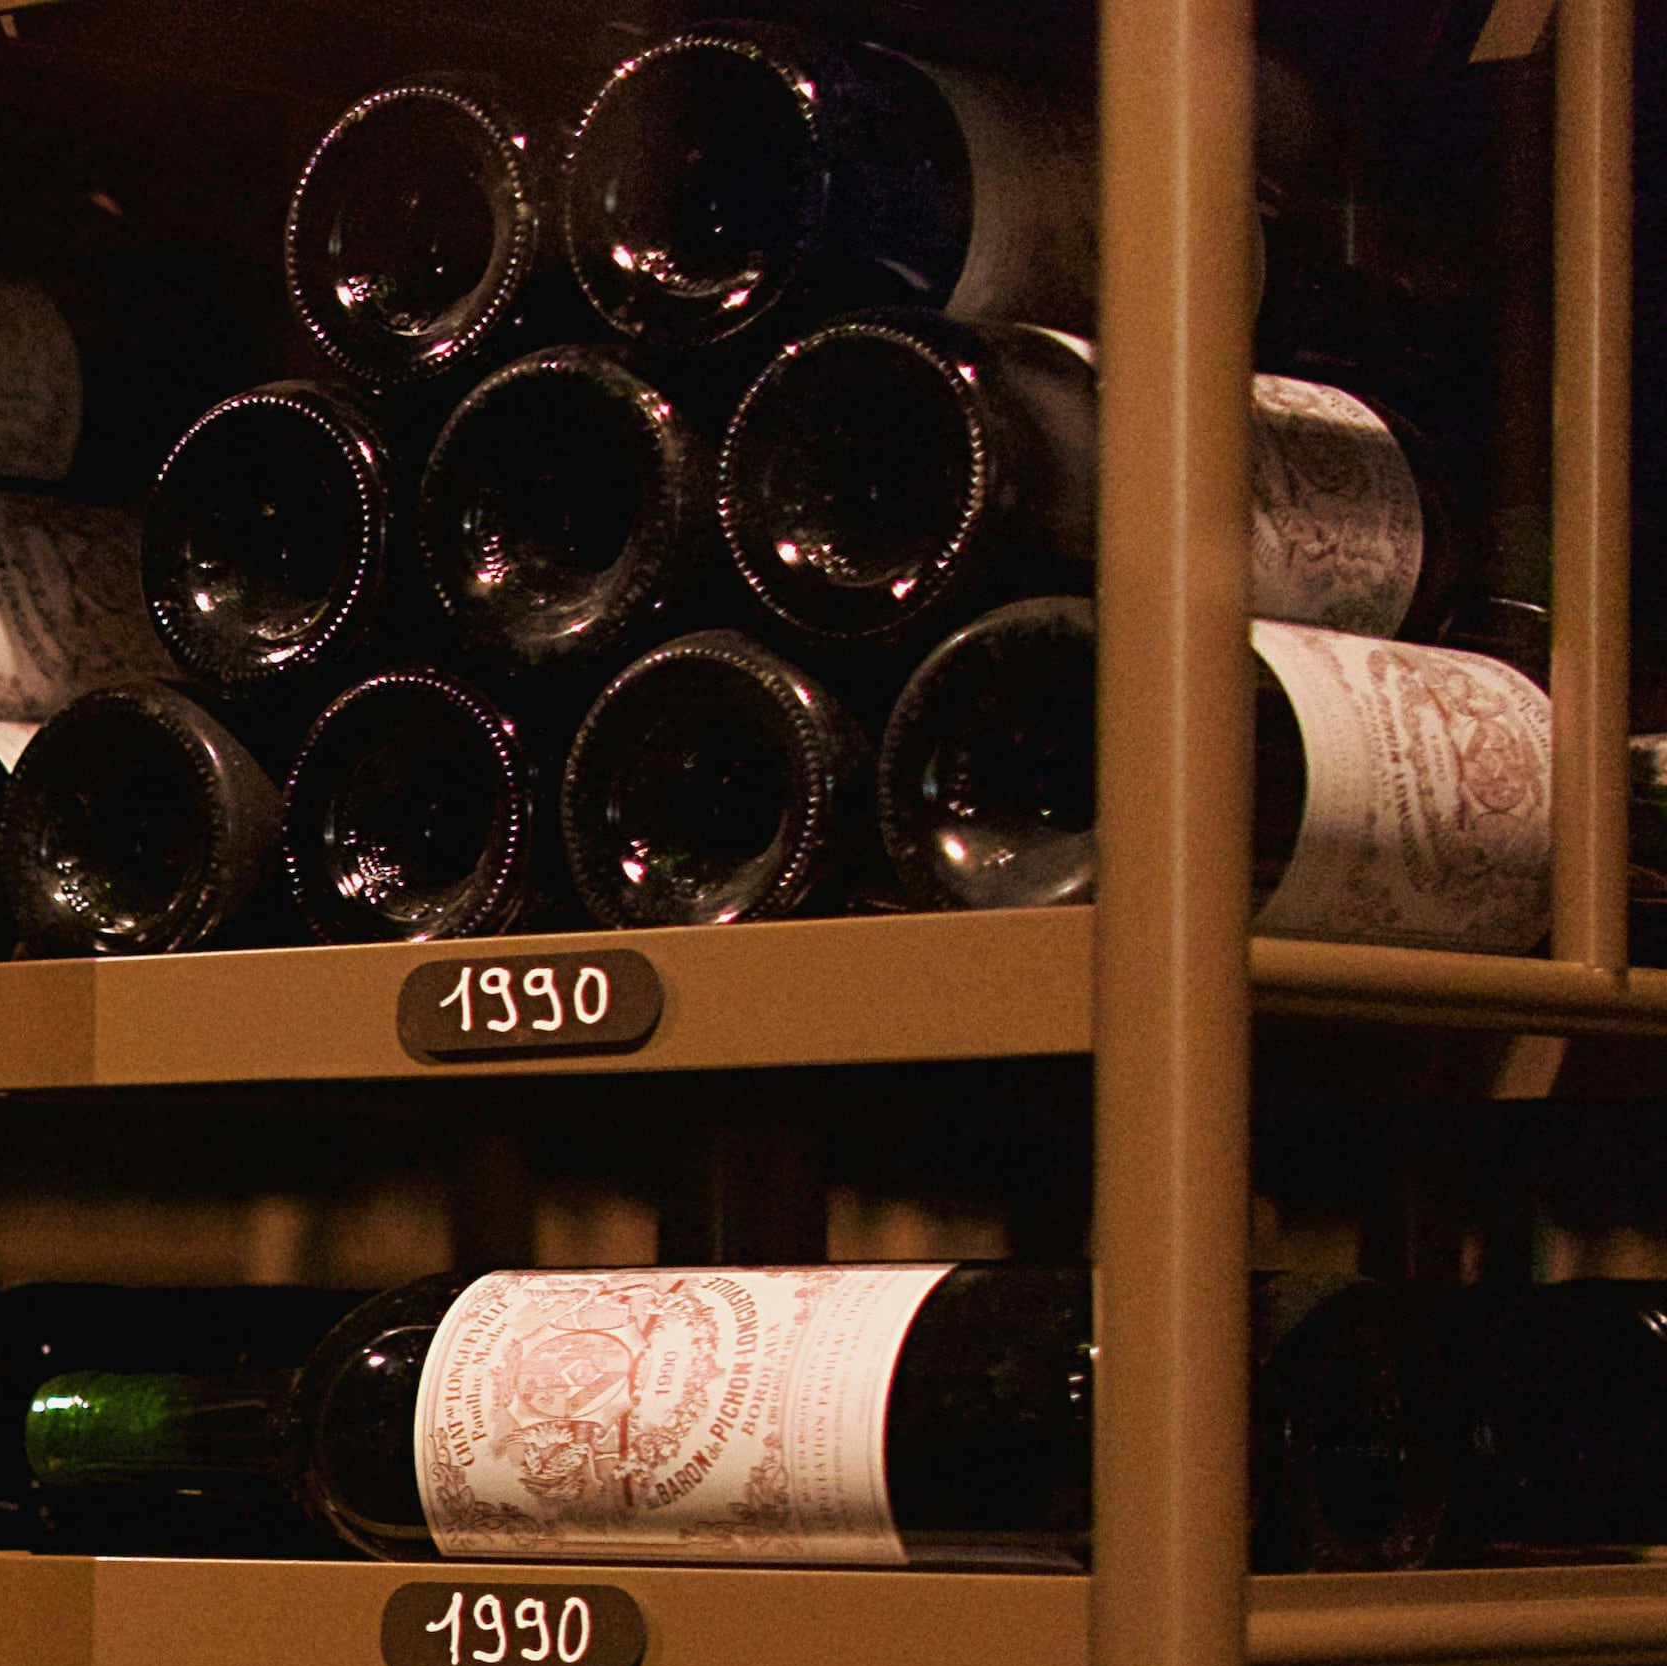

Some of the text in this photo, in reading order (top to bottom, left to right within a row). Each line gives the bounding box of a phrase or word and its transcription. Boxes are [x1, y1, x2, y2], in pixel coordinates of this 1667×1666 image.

[438, 965, 609, 1034] 1990
[700, 1276, 759, 1356] LONGUEVILLE
[654, 1350, 680, 1397] 1990
[707, 1360, 755, 1443] PICHON
[740, 1322, 781, 1436] BORDEAUX
[654, 1448, 713, 1506] BARON
[424, 1590, 591, 1666] 1990
